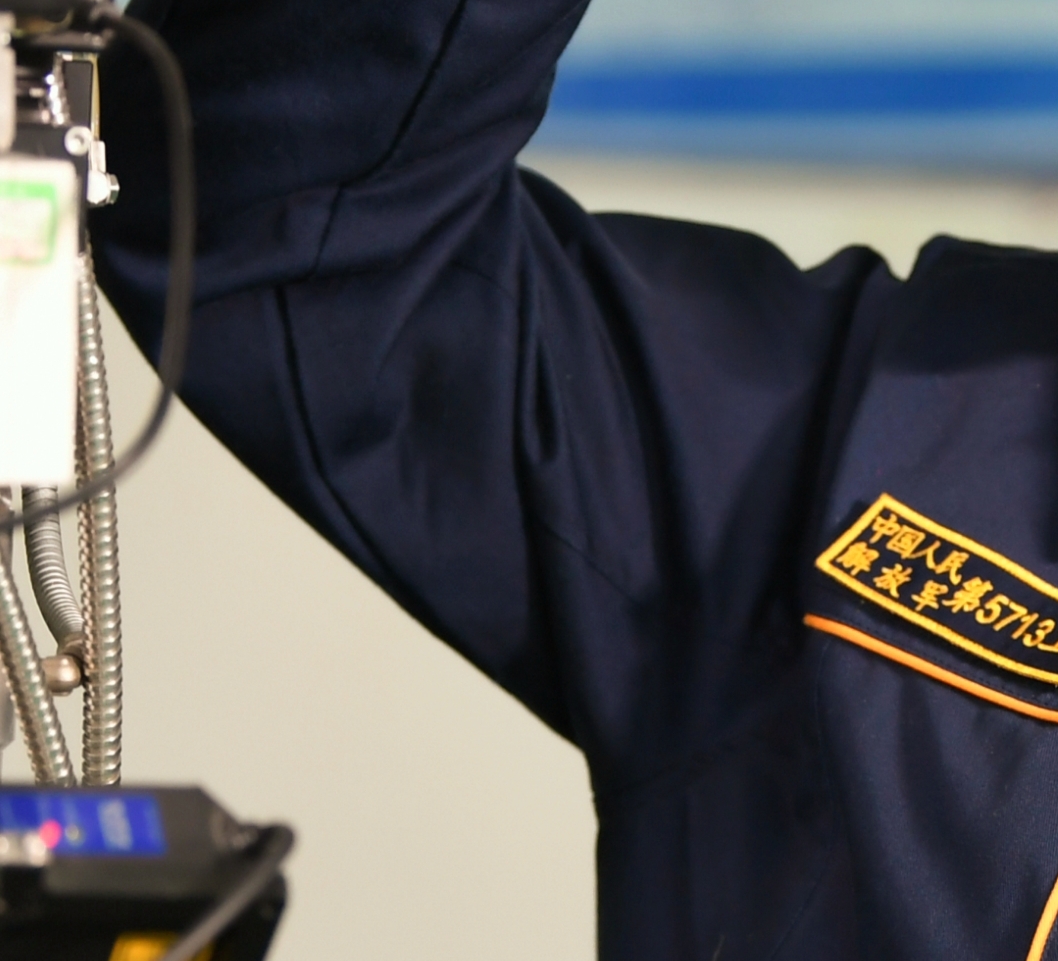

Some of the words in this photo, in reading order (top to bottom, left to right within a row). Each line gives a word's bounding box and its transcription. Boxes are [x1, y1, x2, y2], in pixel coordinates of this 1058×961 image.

[836, 541, 949, 611] 解放军
[869, 513, 969, 585] 中国人民
